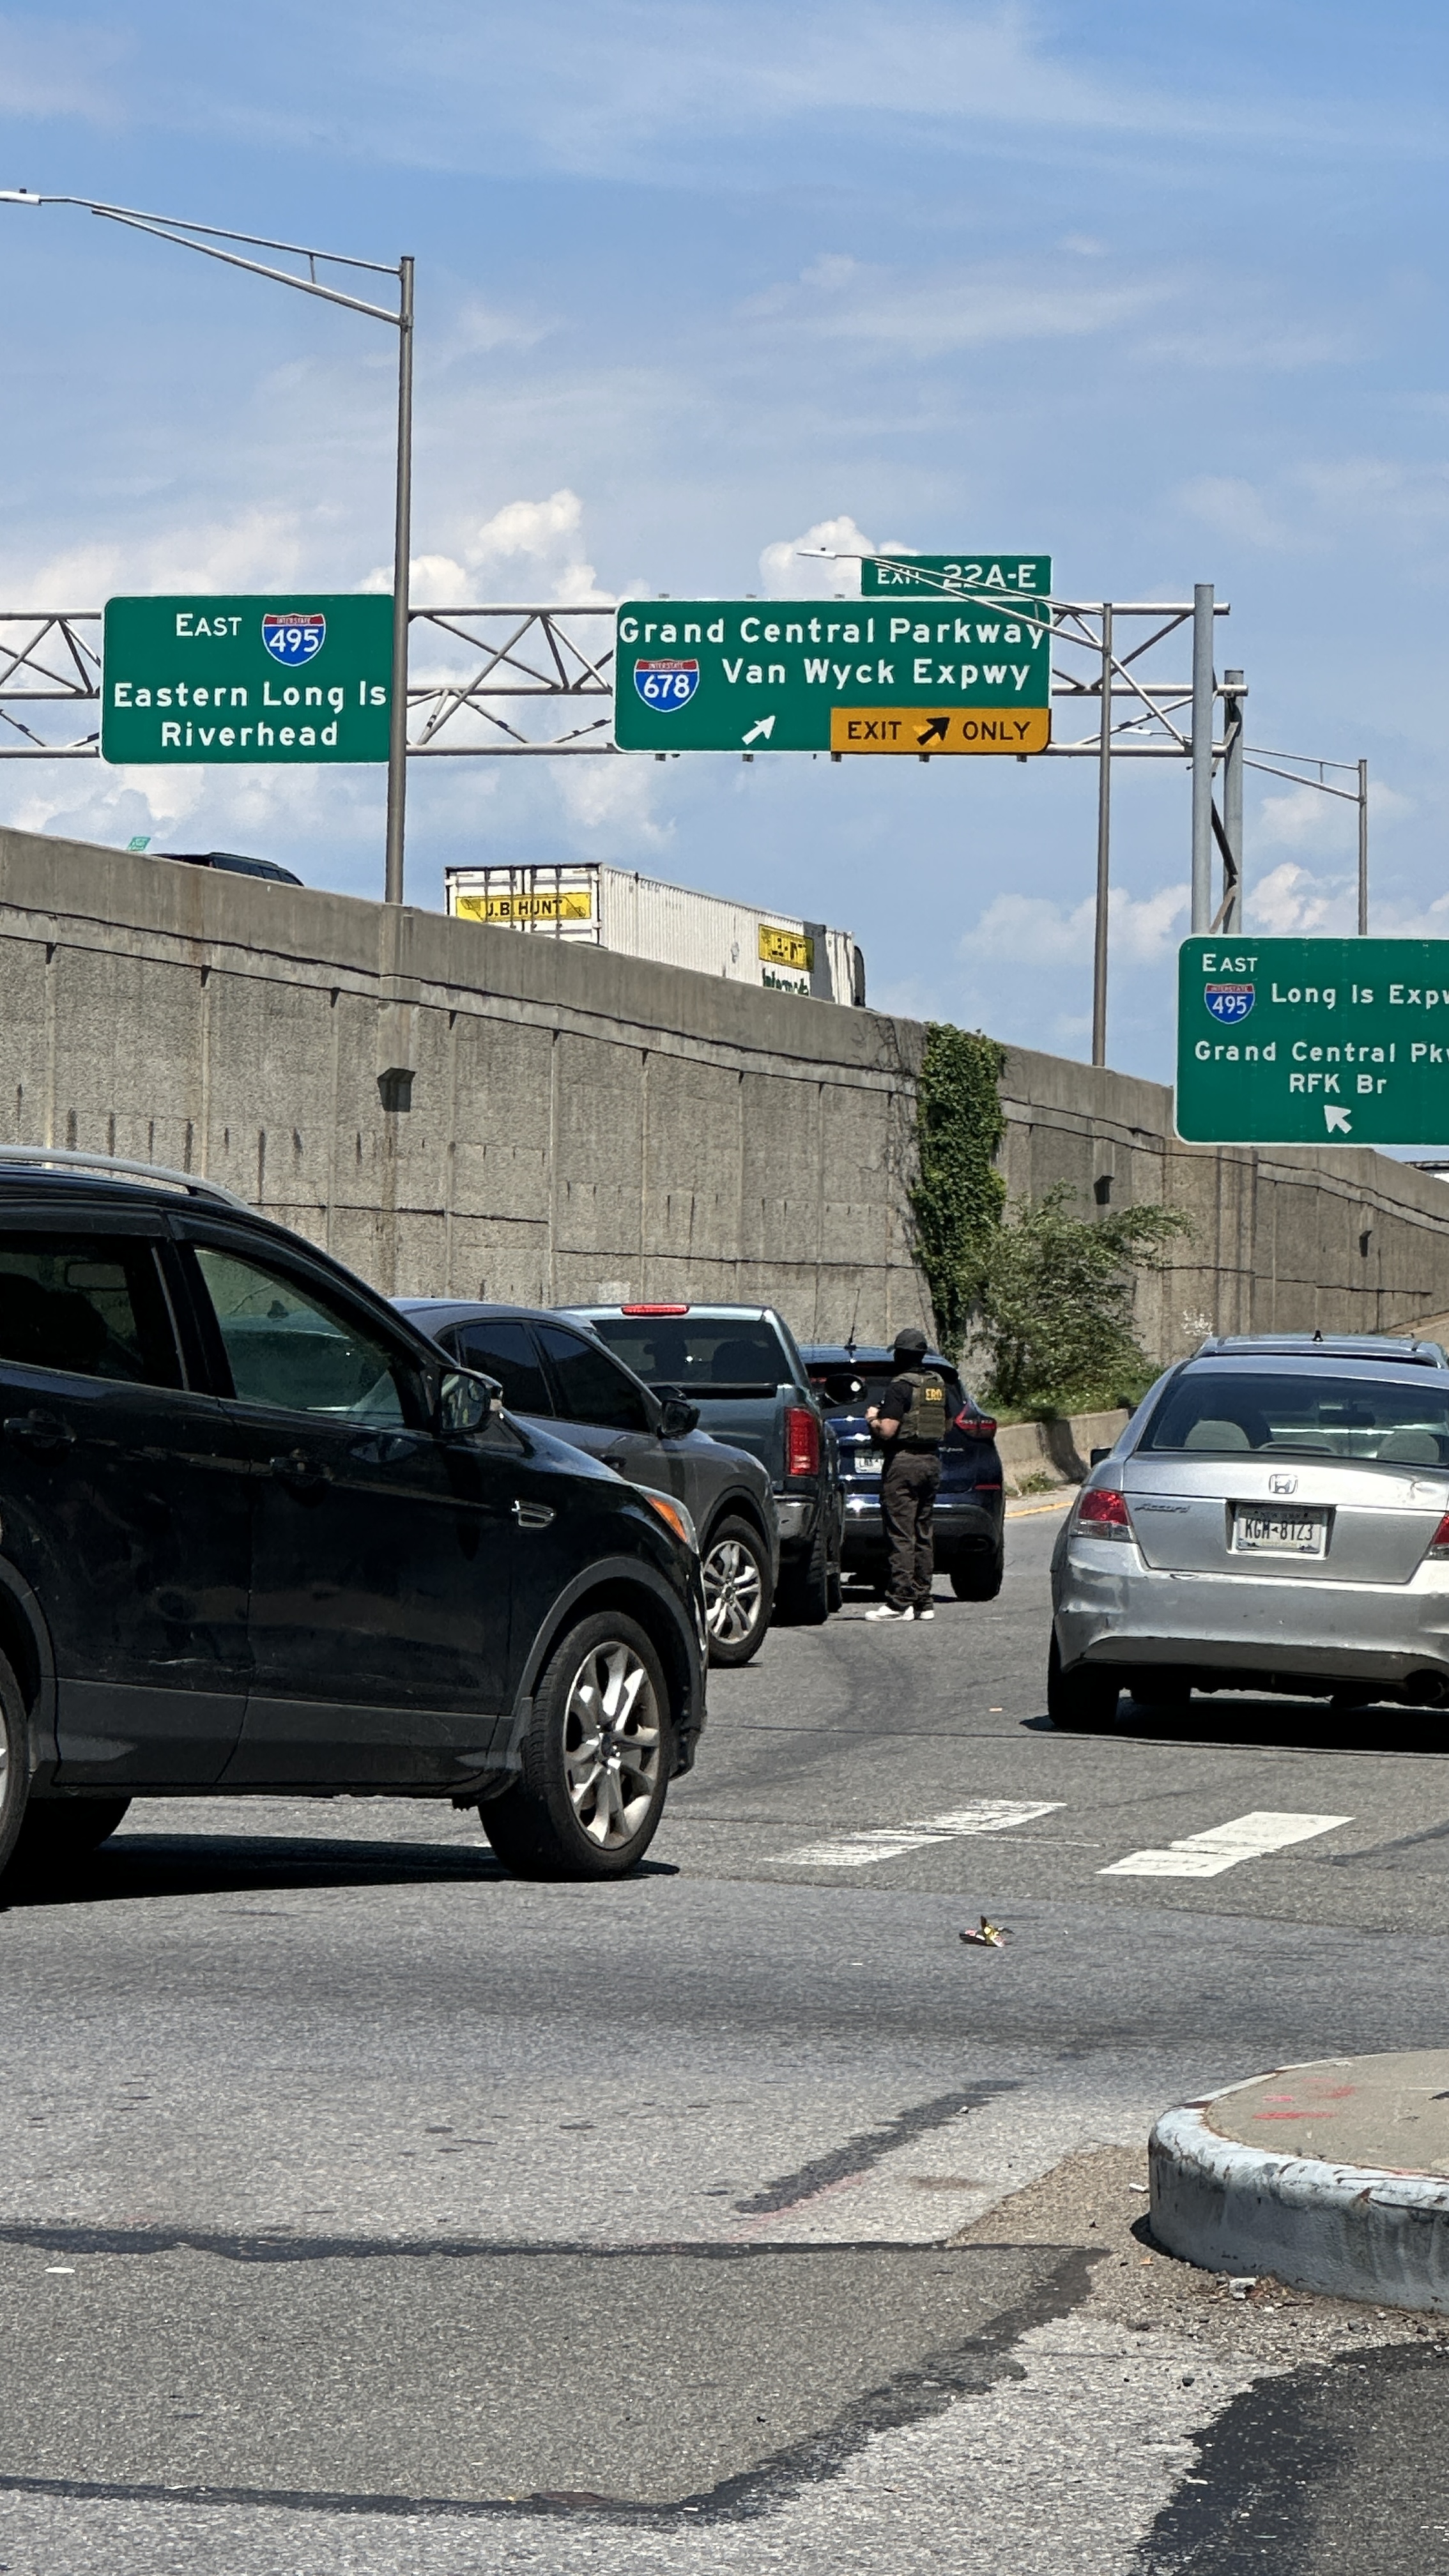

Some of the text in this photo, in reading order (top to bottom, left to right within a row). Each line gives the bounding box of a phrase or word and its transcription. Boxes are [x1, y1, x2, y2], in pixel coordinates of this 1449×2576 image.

[943, 564, 1036, 588] 22A-E
[177, 613, 241, 636] EAST
[619, 618, 1045, 649] Grand Central Parkway
[269, 629, 319, 652] 495
[643, 674, 690, 698] 678
[722, 659, 1030, 691] Van Wyck Expwy
[114, 681, 387, 714] Eastern Long Is
[162, 721, 337, 746] Riverhead
[848, 721, 1031, 740] EXIT ONLY
[519, 900, 563, 915] HUNT
[1202, 954, 1258, 972] EAST
[1212, 995, 1246, 1014] 495
[1272, 983, 1335, 1009] Long
[1353, 985, 1374, 1004] Is
[1195, 1041, 1449, 1062] Grand Central Pk
[1290, 1074, 1387, 1094] RFK Br
